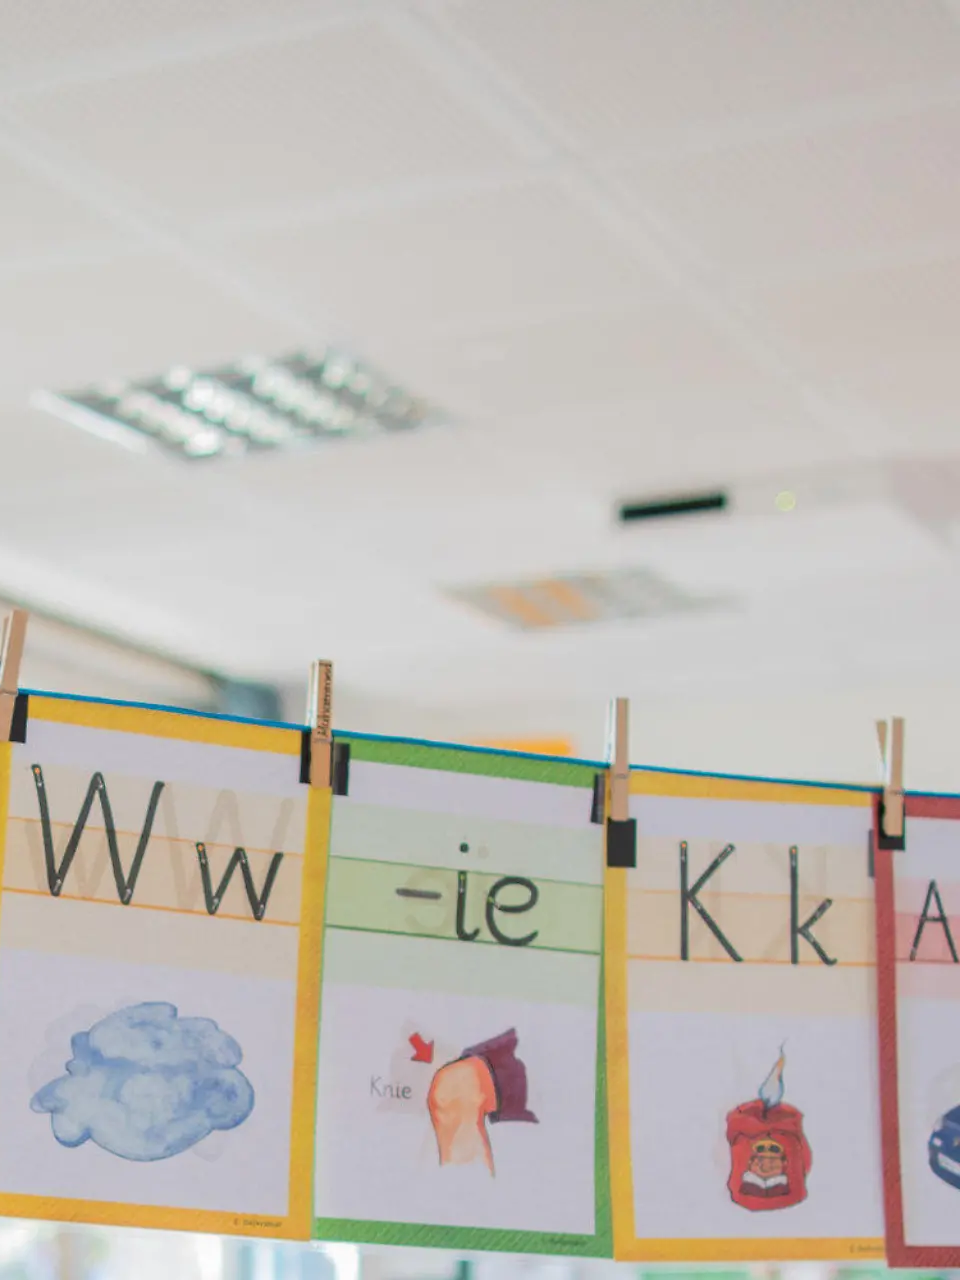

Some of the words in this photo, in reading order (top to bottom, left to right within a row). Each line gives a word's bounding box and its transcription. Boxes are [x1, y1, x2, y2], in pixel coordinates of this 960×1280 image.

[31, 764, 165, 906] W
[196, 842, 284, 921] w
[679, 840, 744, 962] K
[790, 845, 838, 965] k
[910, 880, 959, 964] A
[370, 1075, 412, 1099] Knie
